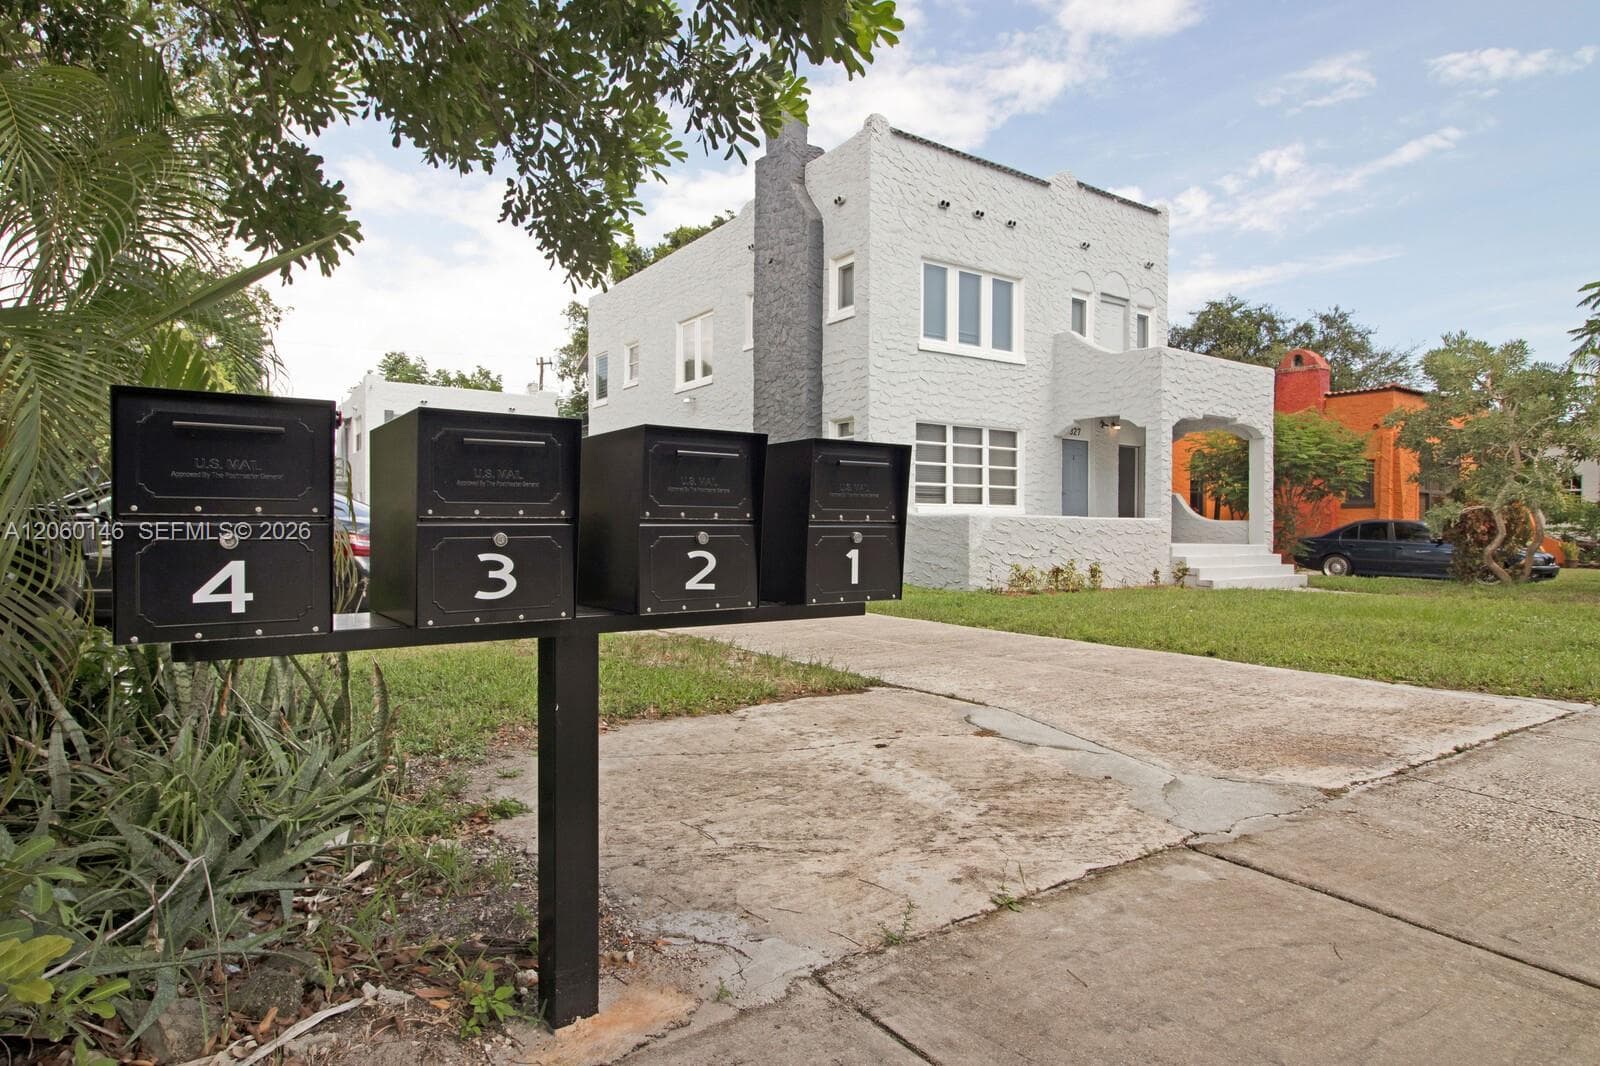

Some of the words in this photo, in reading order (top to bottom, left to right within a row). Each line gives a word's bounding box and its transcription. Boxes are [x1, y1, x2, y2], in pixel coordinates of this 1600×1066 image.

[192, 560, 254, 614] 4
[474, 552, 518, 600] 3
[685, 550, 717, 590] 2
[846, 549, 859, 584] 1
